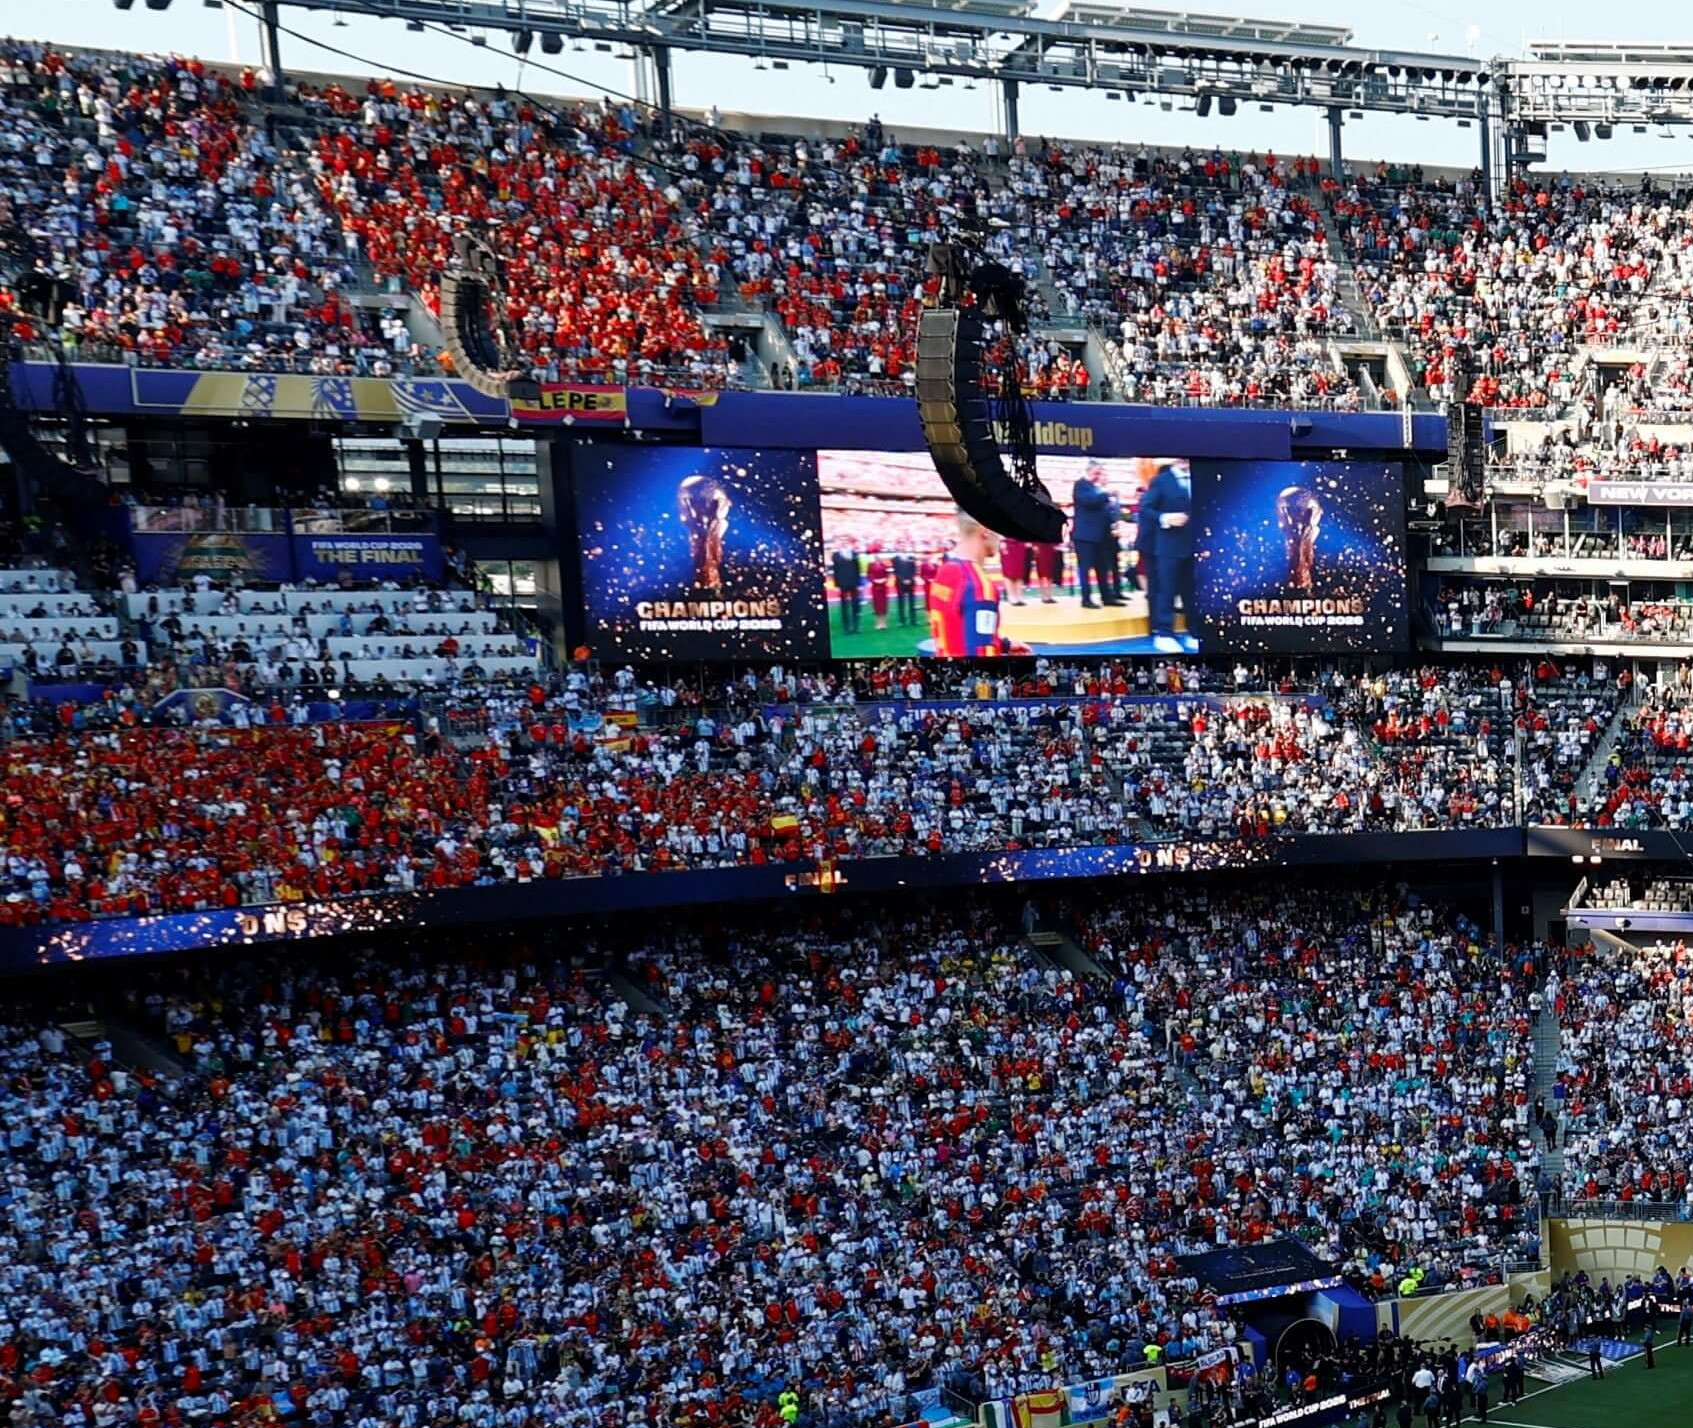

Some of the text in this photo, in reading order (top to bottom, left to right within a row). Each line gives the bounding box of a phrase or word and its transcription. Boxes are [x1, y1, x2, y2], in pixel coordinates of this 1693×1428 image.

[1600, 488, 1648, 499] NEW
[316, 550, 423, 562] THE FINAL
[635, 601, 780, 617] CHAMPIONS
[1238, 599, 1363, 614] CHAMPIONS
[640, 620, 668, 630] FIFA
[668, 620, 712, 631] WORLD
[713, 619, 738, 630] CUP
[1240, 616, 1265, 625] FIFA
[1265, 616, 1303, 626] WORLD
[1304, 616, 1326, 625] CUP
